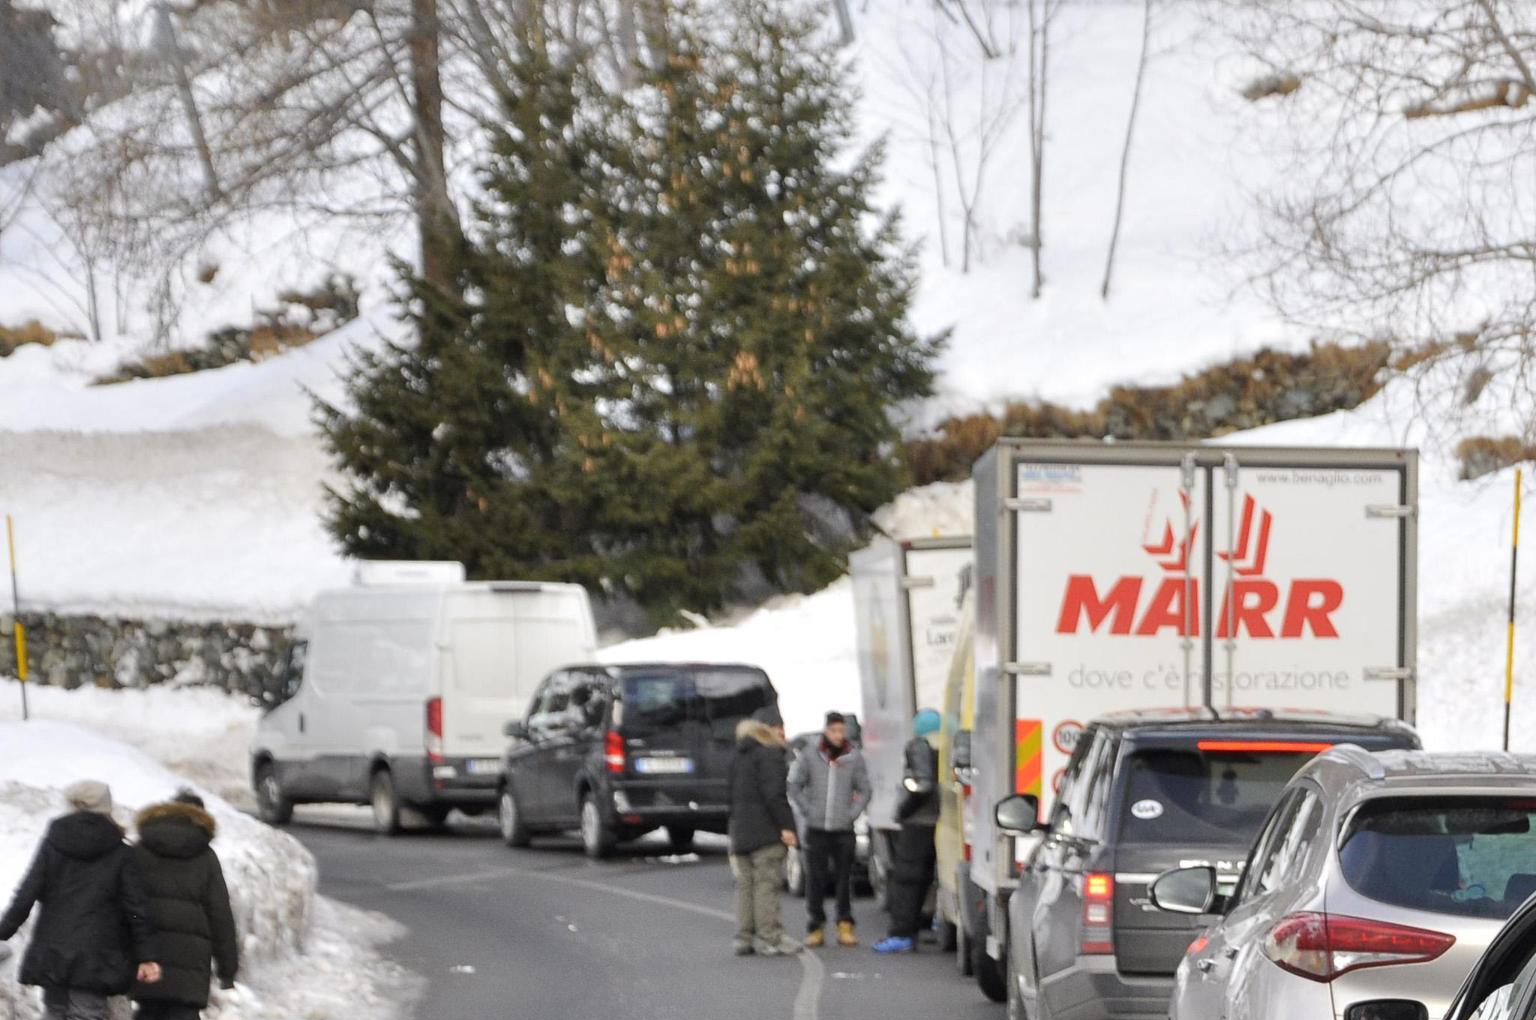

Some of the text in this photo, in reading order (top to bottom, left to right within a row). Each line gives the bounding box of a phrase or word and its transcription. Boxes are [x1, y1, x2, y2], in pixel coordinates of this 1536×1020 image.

[1055, 574, 1344, 639] MARR
[1067, 663, 1133, 690] dove
[1186, 664, 1350, 692] risorazione
